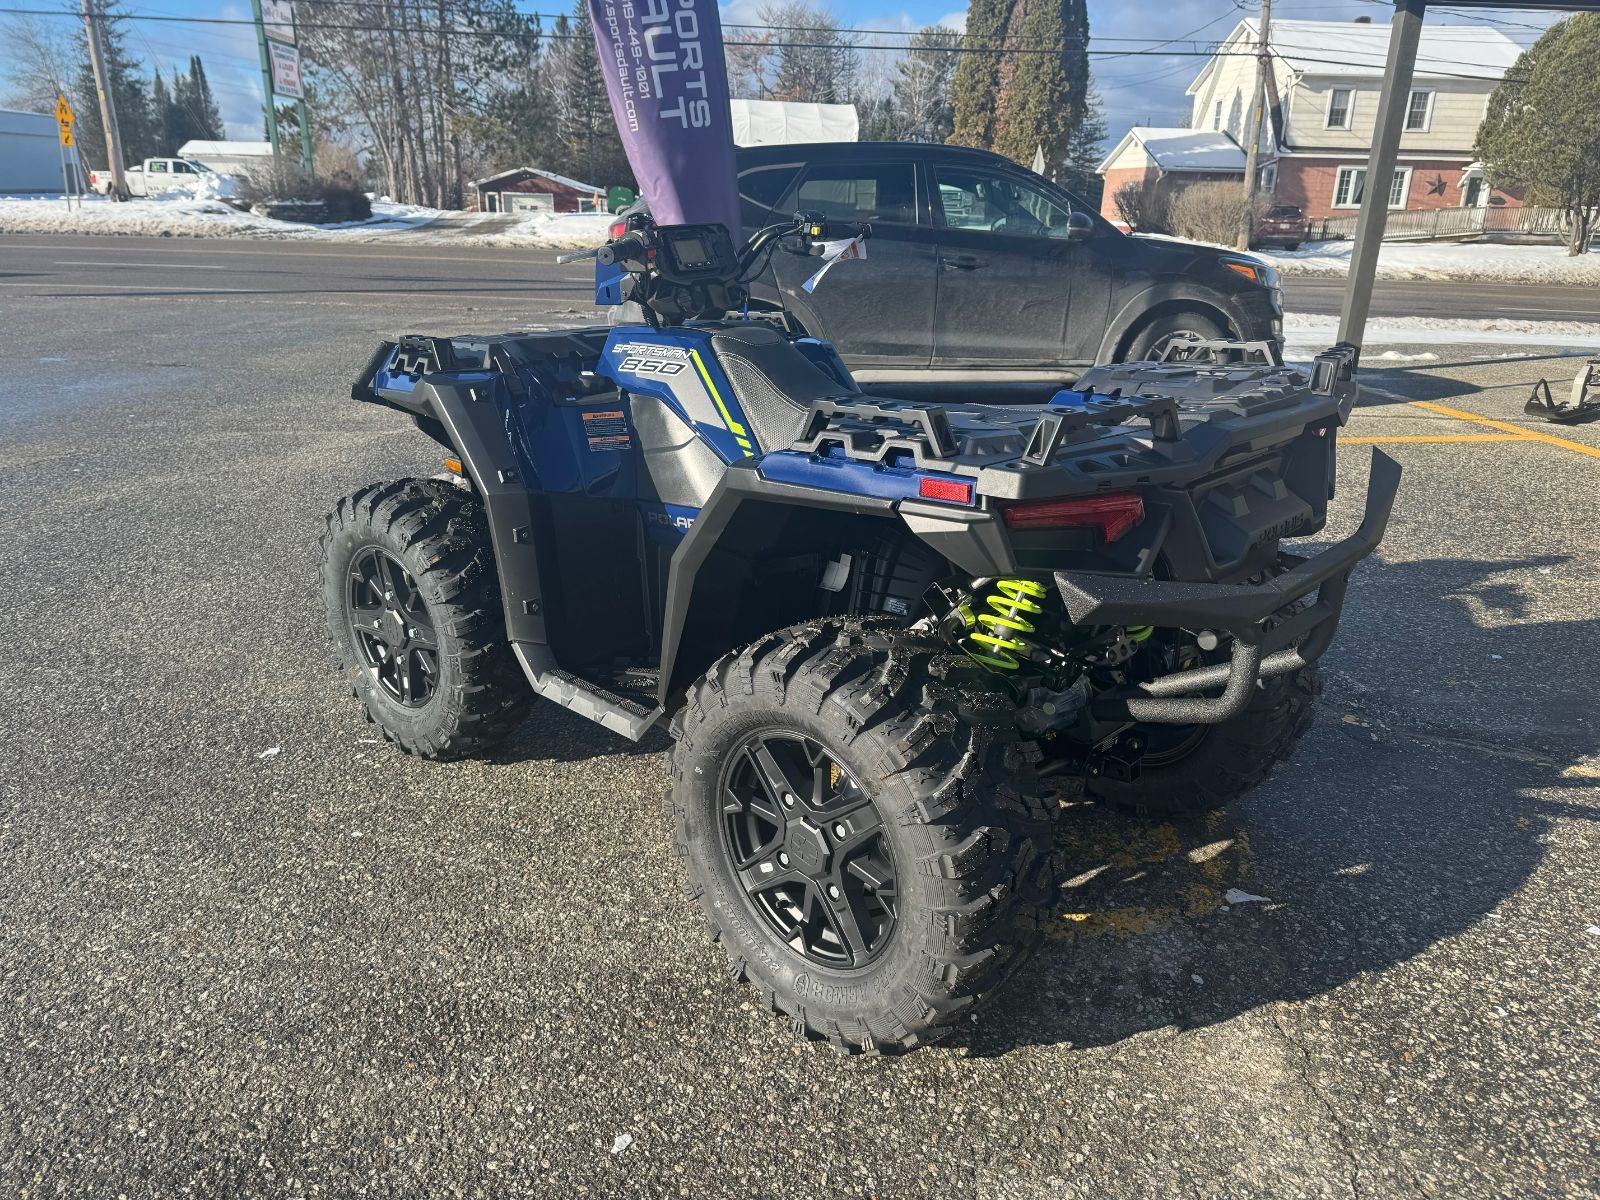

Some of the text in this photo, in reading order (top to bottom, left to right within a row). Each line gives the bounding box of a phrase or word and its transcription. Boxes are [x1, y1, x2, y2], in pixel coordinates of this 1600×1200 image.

[622, 0, 651, 99] 19-449-1001
[612, 343, 693, 360] SPORTSMAN
[618, 357, 688, 376] 850
